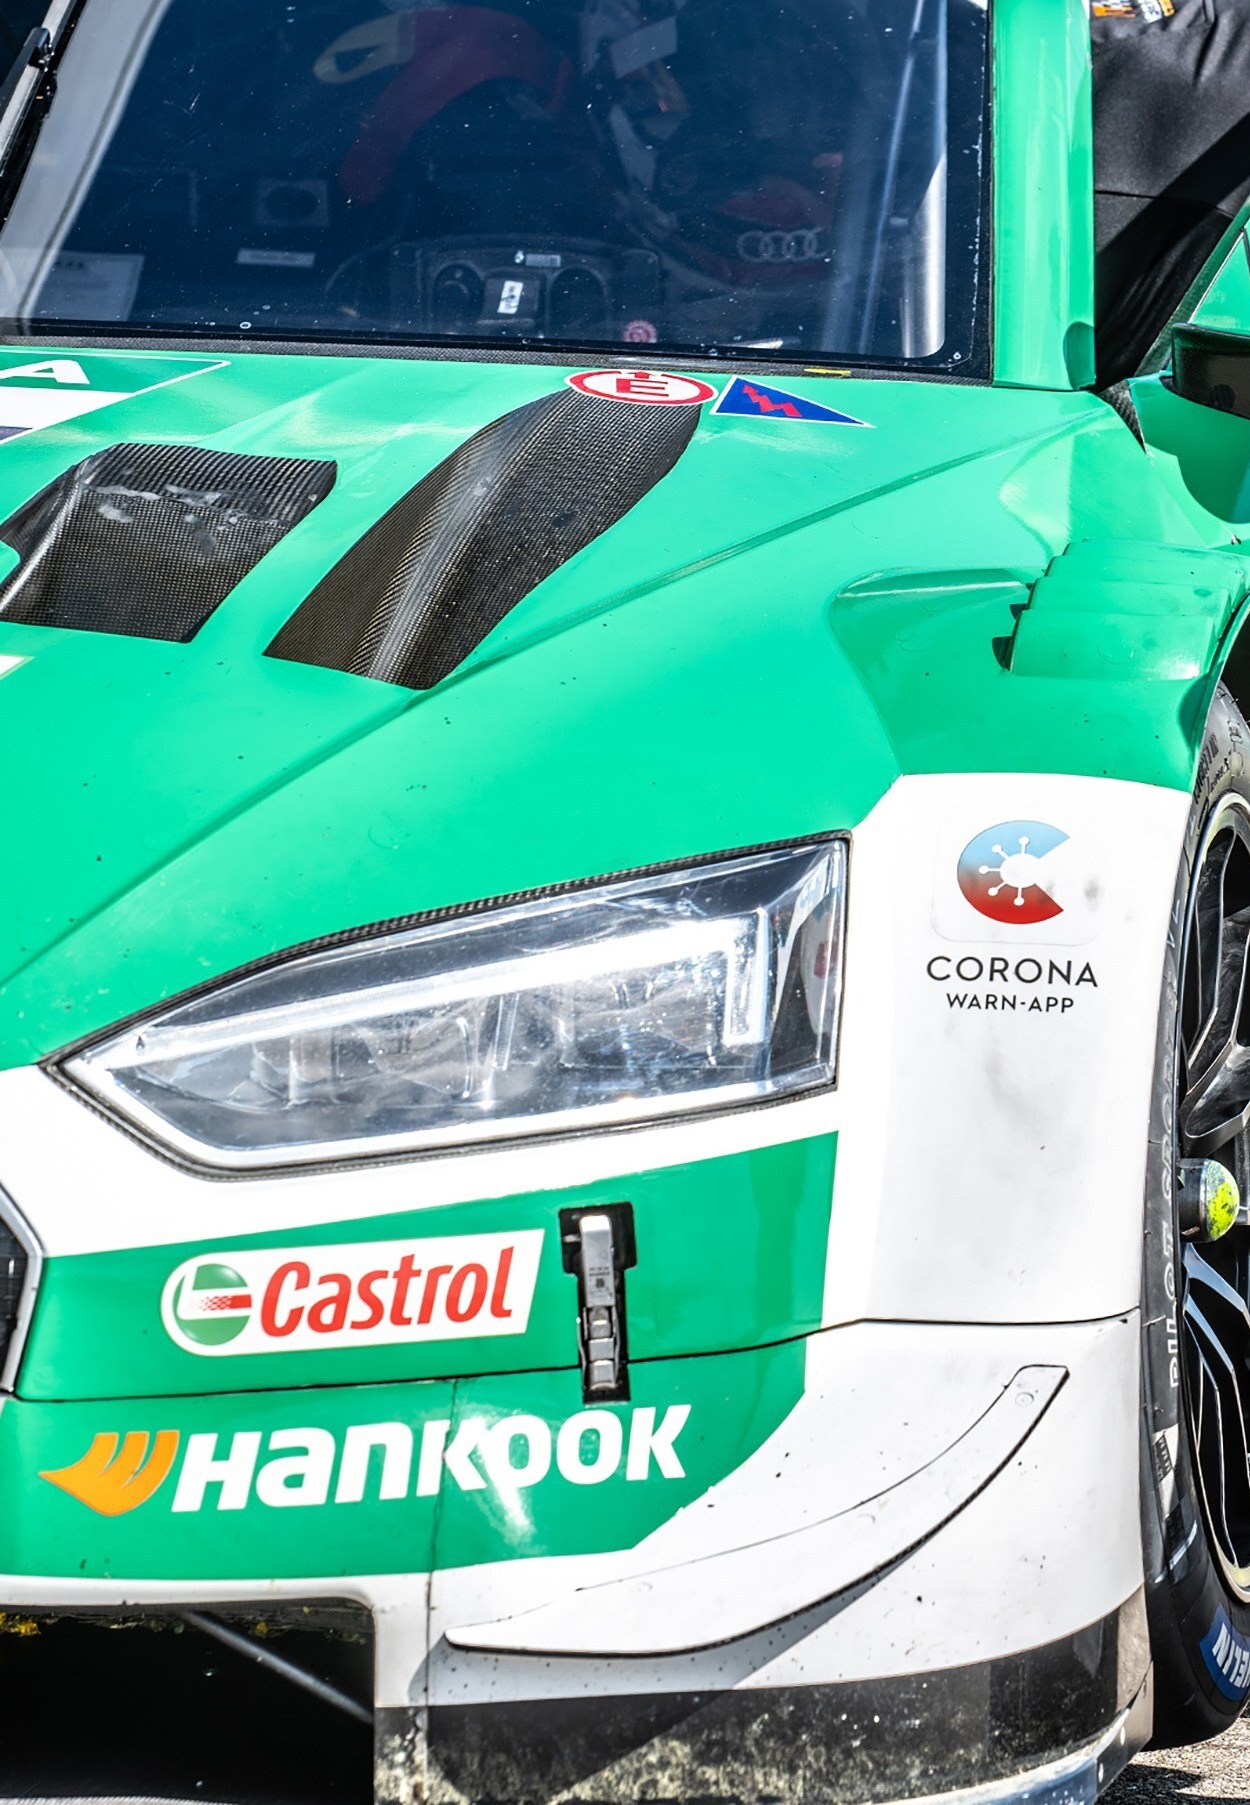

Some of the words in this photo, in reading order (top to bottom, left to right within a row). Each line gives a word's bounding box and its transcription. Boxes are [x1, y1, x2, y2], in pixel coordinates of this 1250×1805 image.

[926, 955, 1099, 988] CORONA
[946, 992, 1075, 1014] WARN-APP
[259, 1246, 515, 1338] Castrol
